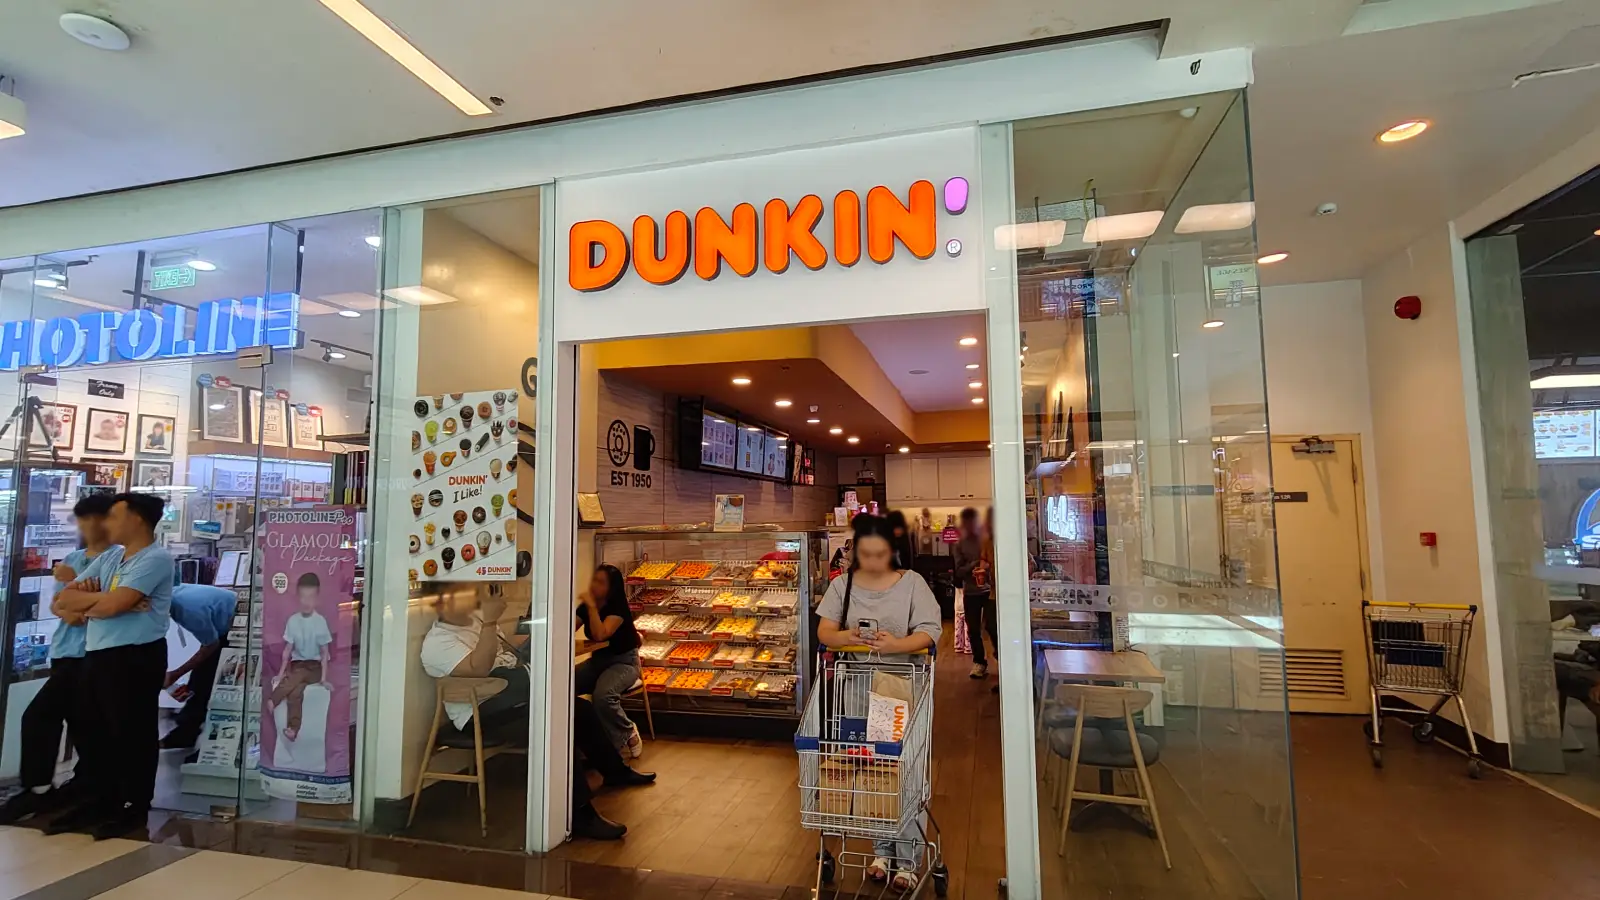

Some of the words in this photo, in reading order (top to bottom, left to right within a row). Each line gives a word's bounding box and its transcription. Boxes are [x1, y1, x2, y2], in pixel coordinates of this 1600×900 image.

[568, 177, 969, 293] DUNKIN'
[448, 475, 488, 486] DUNKIN'
[611, 470, 629, 486] EST
[631, 472, 652, 488] 1950
[453, 490, 459, 504] I
[460, 485, 483, 500] Like!
[266, 531, 351, 549] GLAMOUR
[280, 543, 353, 576] Package
